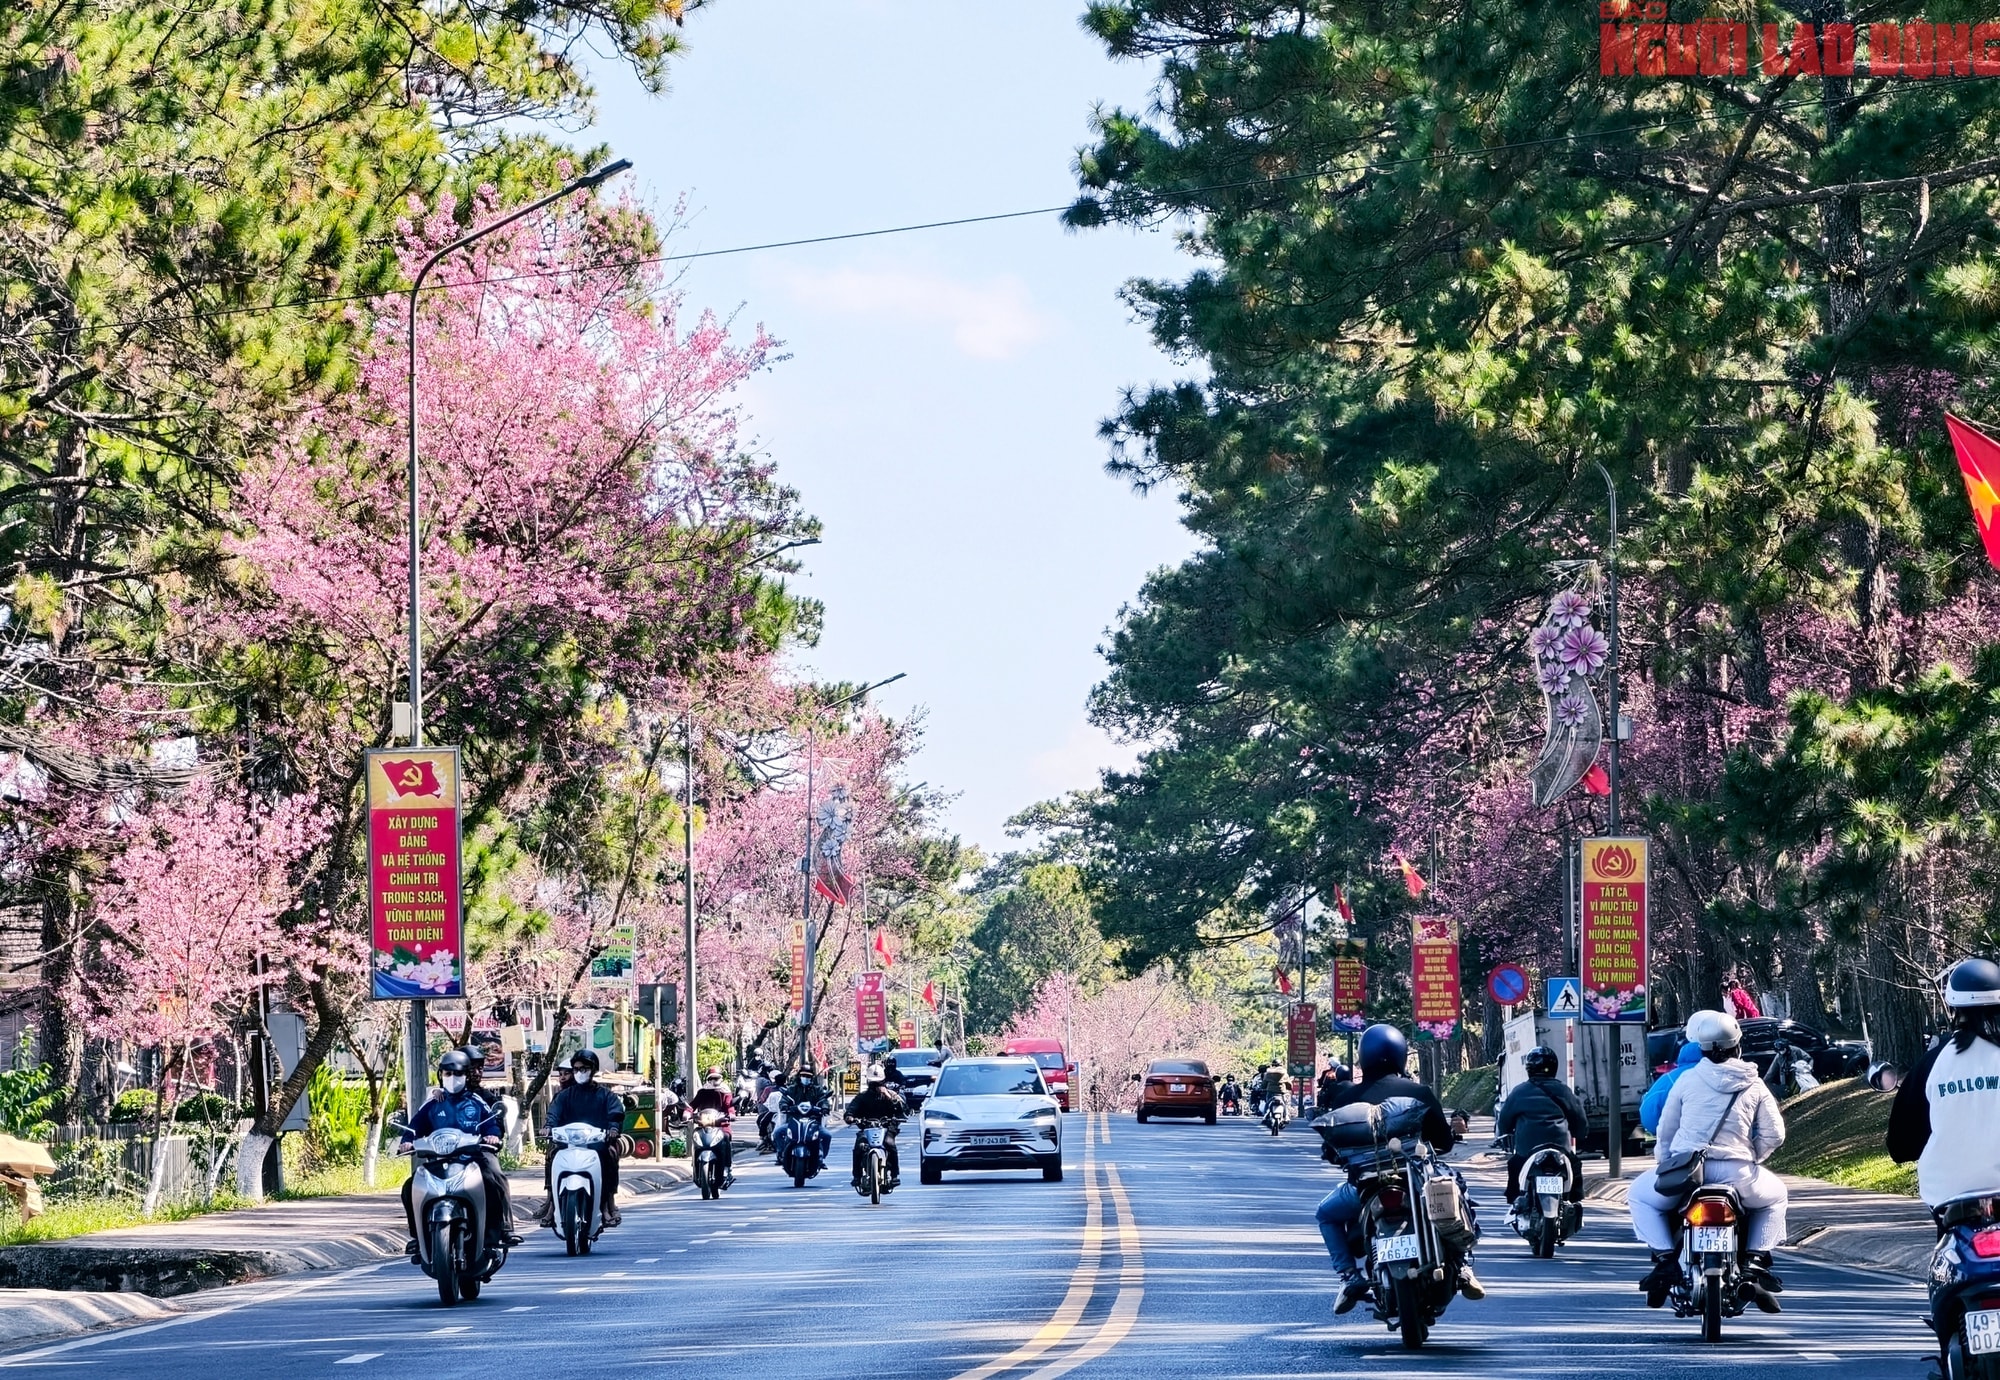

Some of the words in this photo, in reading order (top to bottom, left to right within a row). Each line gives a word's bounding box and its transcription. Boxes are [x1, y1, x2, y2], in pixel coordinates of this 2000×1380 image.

[389, 814, 408, 829] XÂY
[411, 815, 438, 831] DỰNG
[400, 831, 427, 848] ĐẢNG
[382, 851, 395, 867] VÀ
[398, 851, 410, 868] HỆ
[413, 849, 445, 866] THỐNG
[390, 870, 420, 885] CHÍNH
[423, 872, 438, 887] TRỊ
[1600, 883, 1615, 897] TẤT
[1617, 884, 1628, 897] CẢ
[382, 892, 415, 904] TRONG
[418, 891, 447, 905] SẠCH,
[1590, 899, 1598, 912] VÌ
[1600, 901, 1618, 914] MỤC
[1621, 900, 1638, 912] TIÊU
[385, 908, 412, 922] VỮNG
[415, 909, 445, 924] MẠNH
[1594, 913, 1611, 926] DÂN
[387, 926, 413, 941] TOÀN
[416, 925, 443, 943] DIỆN!
[1588, 927, 1611, 940] NƯỚC
[1595, 942, 1612, 954] DÂN
[1590, 956, 1612, 968] CÔNG
[1592, 970, 1609, 982] VĂN
[1611, 972, 1636, 983] MINH!
[1938, 1075, 2000, 1098] FOLLOW
[1383, 1236, 1412, 1250] 77-F1
[1698, 1239, 1728, 1251] 4058
[1380, 1247, 1417, 1261] 266.29
